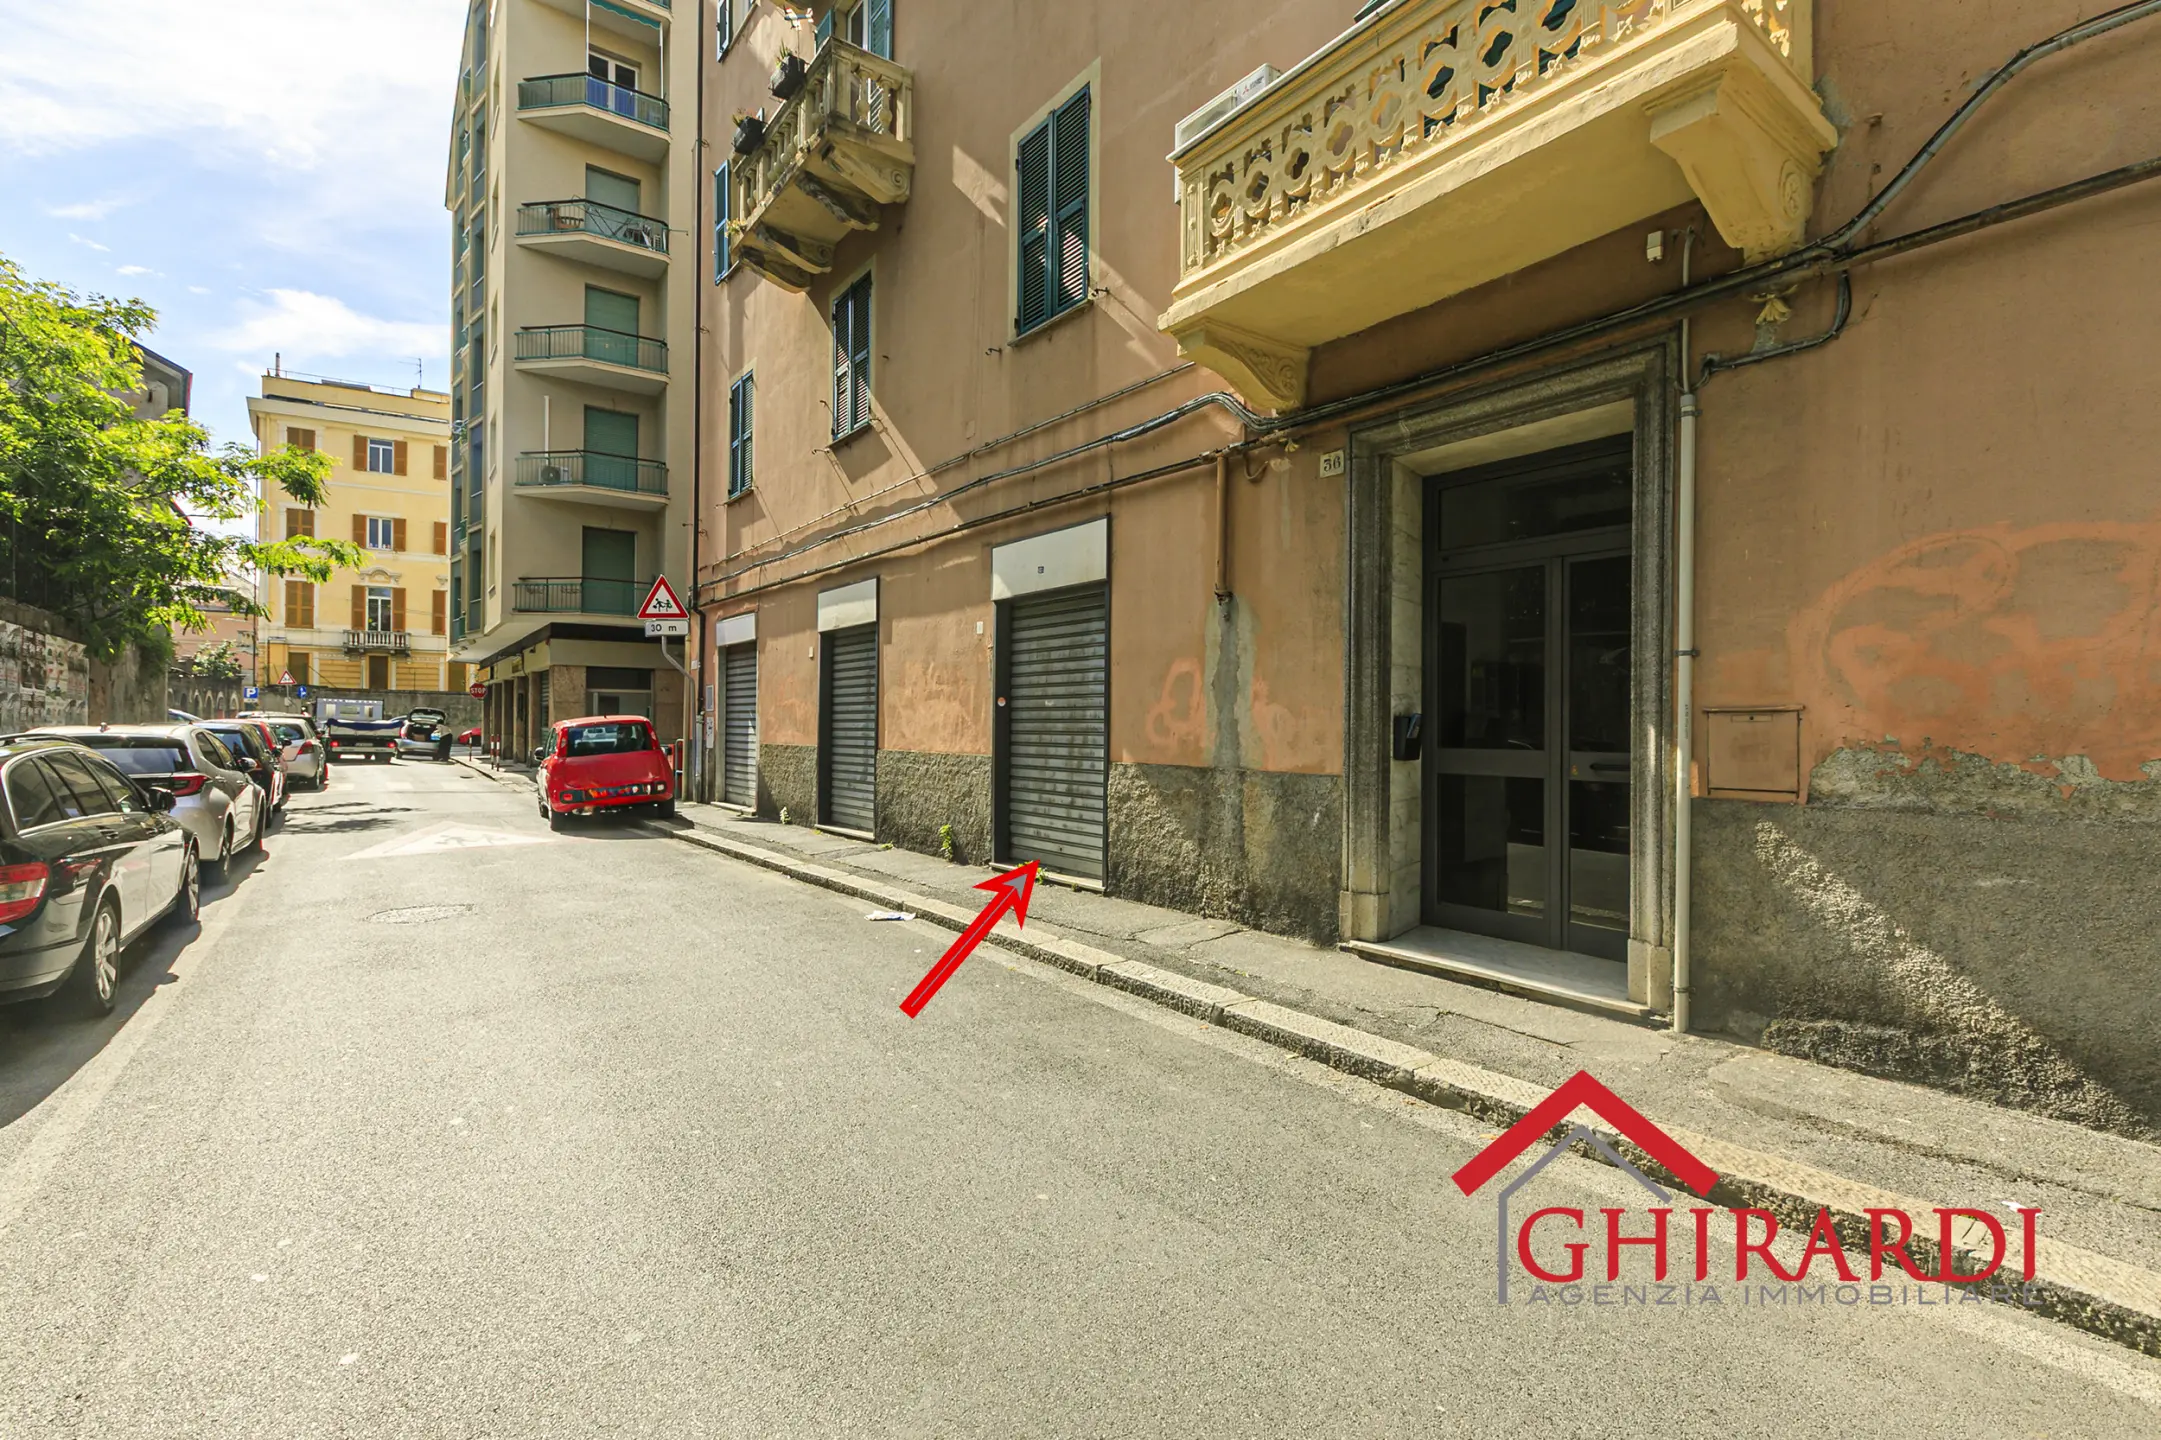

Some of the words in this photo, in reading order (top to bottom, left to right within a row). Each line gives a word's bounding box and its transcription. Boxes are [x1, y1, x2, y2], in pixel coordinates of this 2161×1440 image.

[1323, 455, 1341, 472] 36
[650, 623, 662, 632] 30
[246, 688, 257, 698] P
